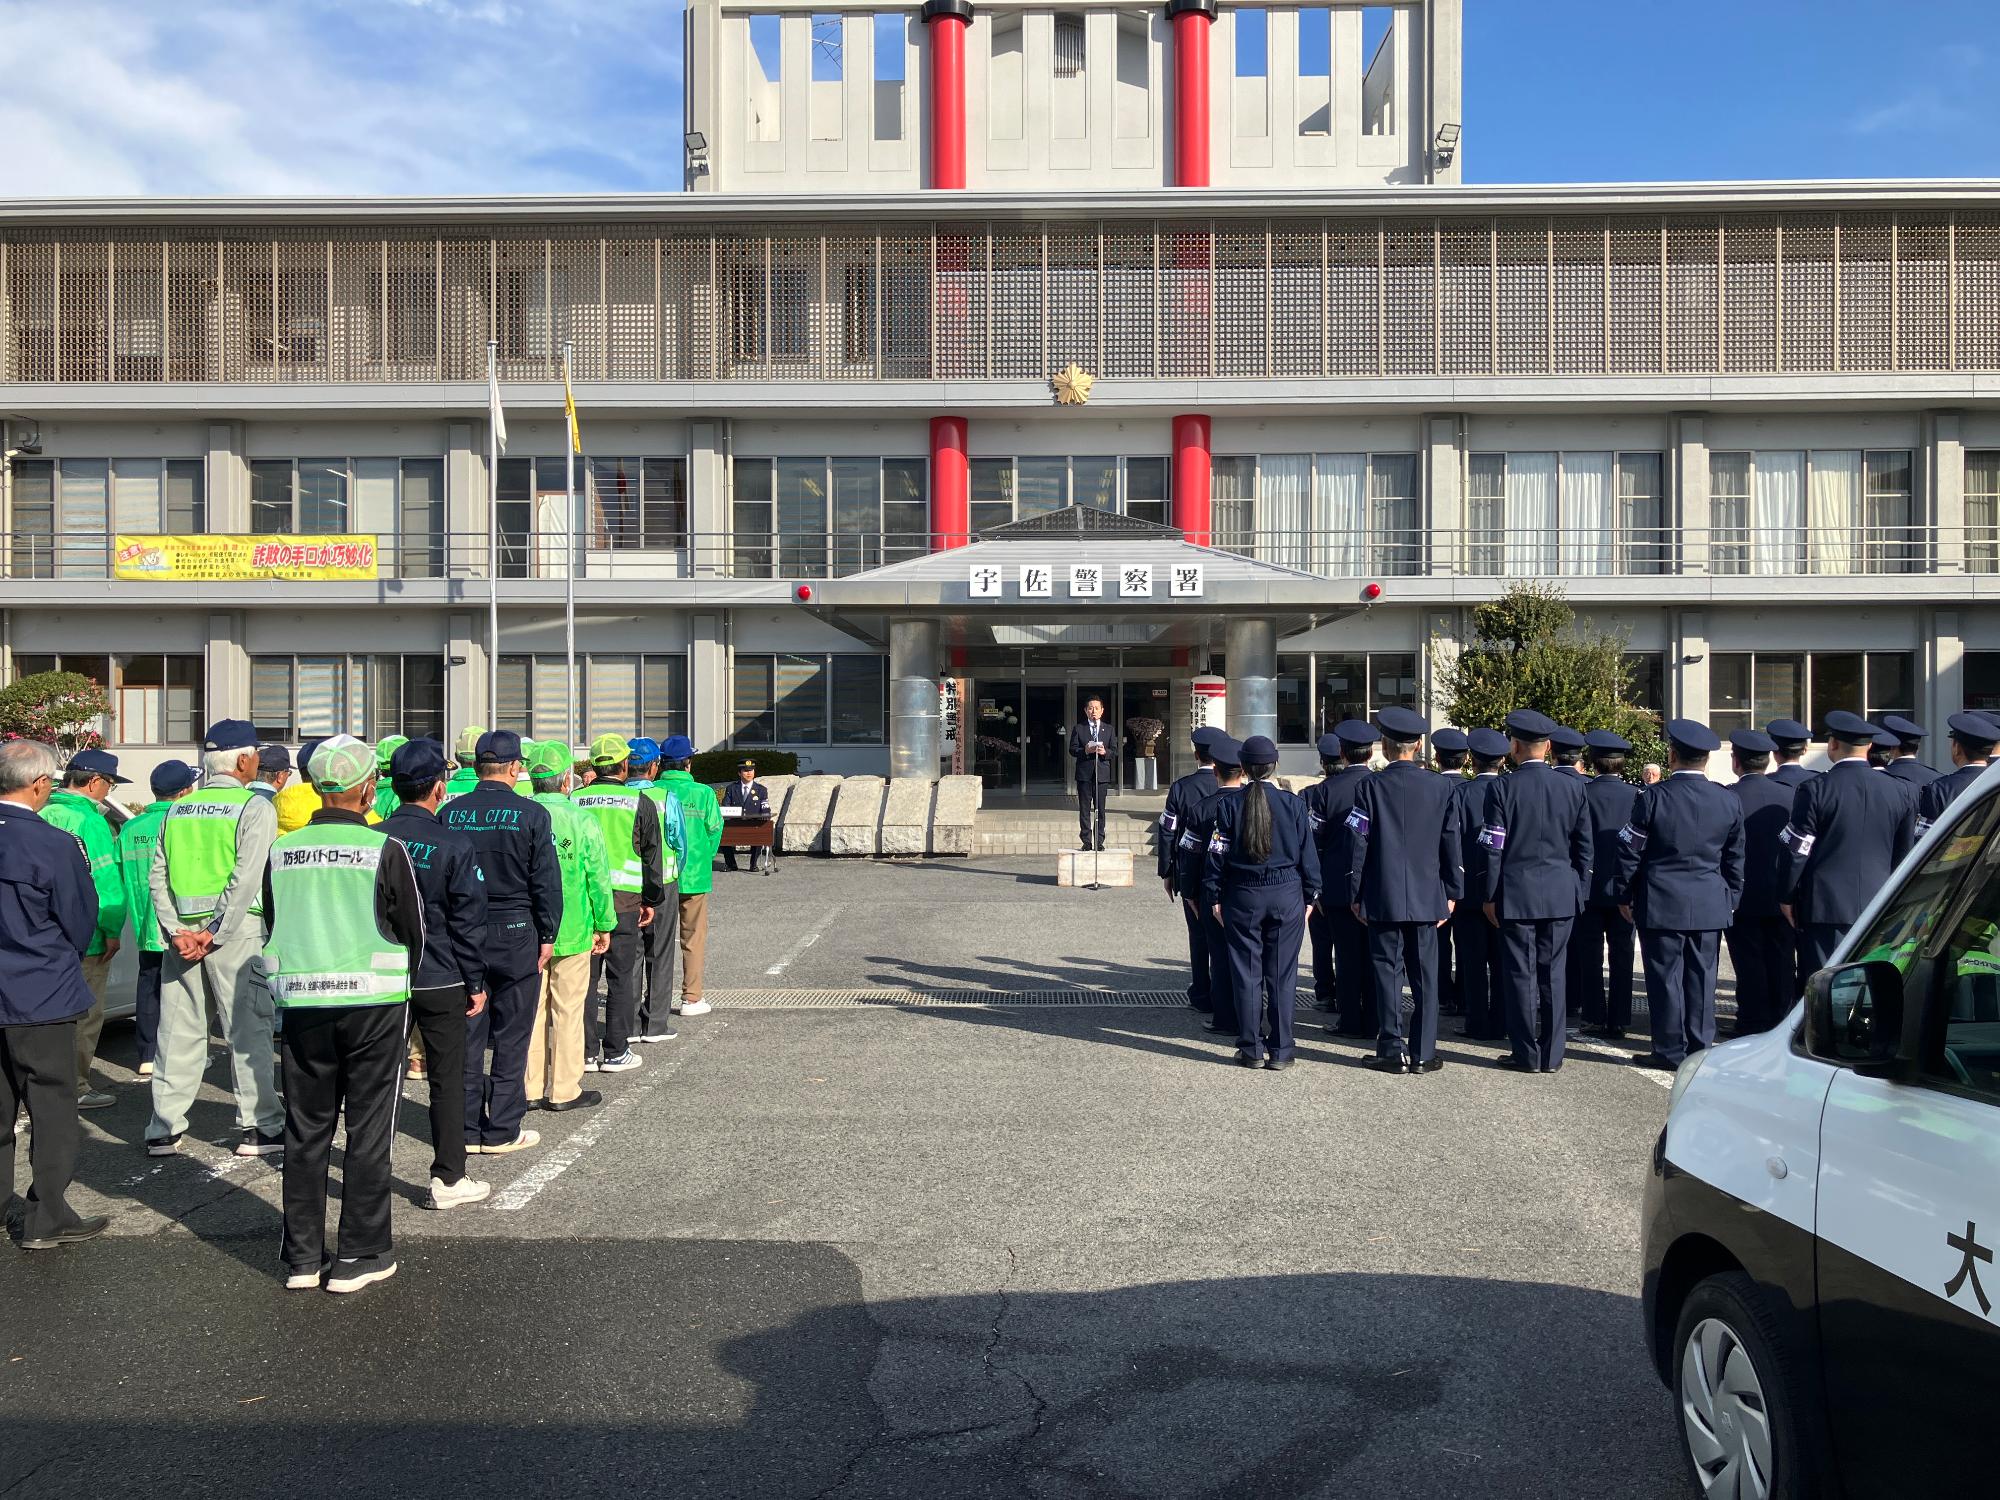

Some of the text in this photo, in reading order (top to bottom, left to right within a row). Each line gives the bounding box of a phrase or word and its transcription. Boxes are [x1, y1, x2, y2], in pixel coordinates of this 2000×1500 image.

[252, 543, 373, 567] 詐欺の手口が巧妙化
[973, 567, 1200, 594] 宇佐警察署
[176, 804, 231, 815] 防犯パトロール
[448, 809, 523, 824] USA CITY
[283, 850, 364, 866] 防犯パトロール
[1944, 1220, 1993, 1316] 大
